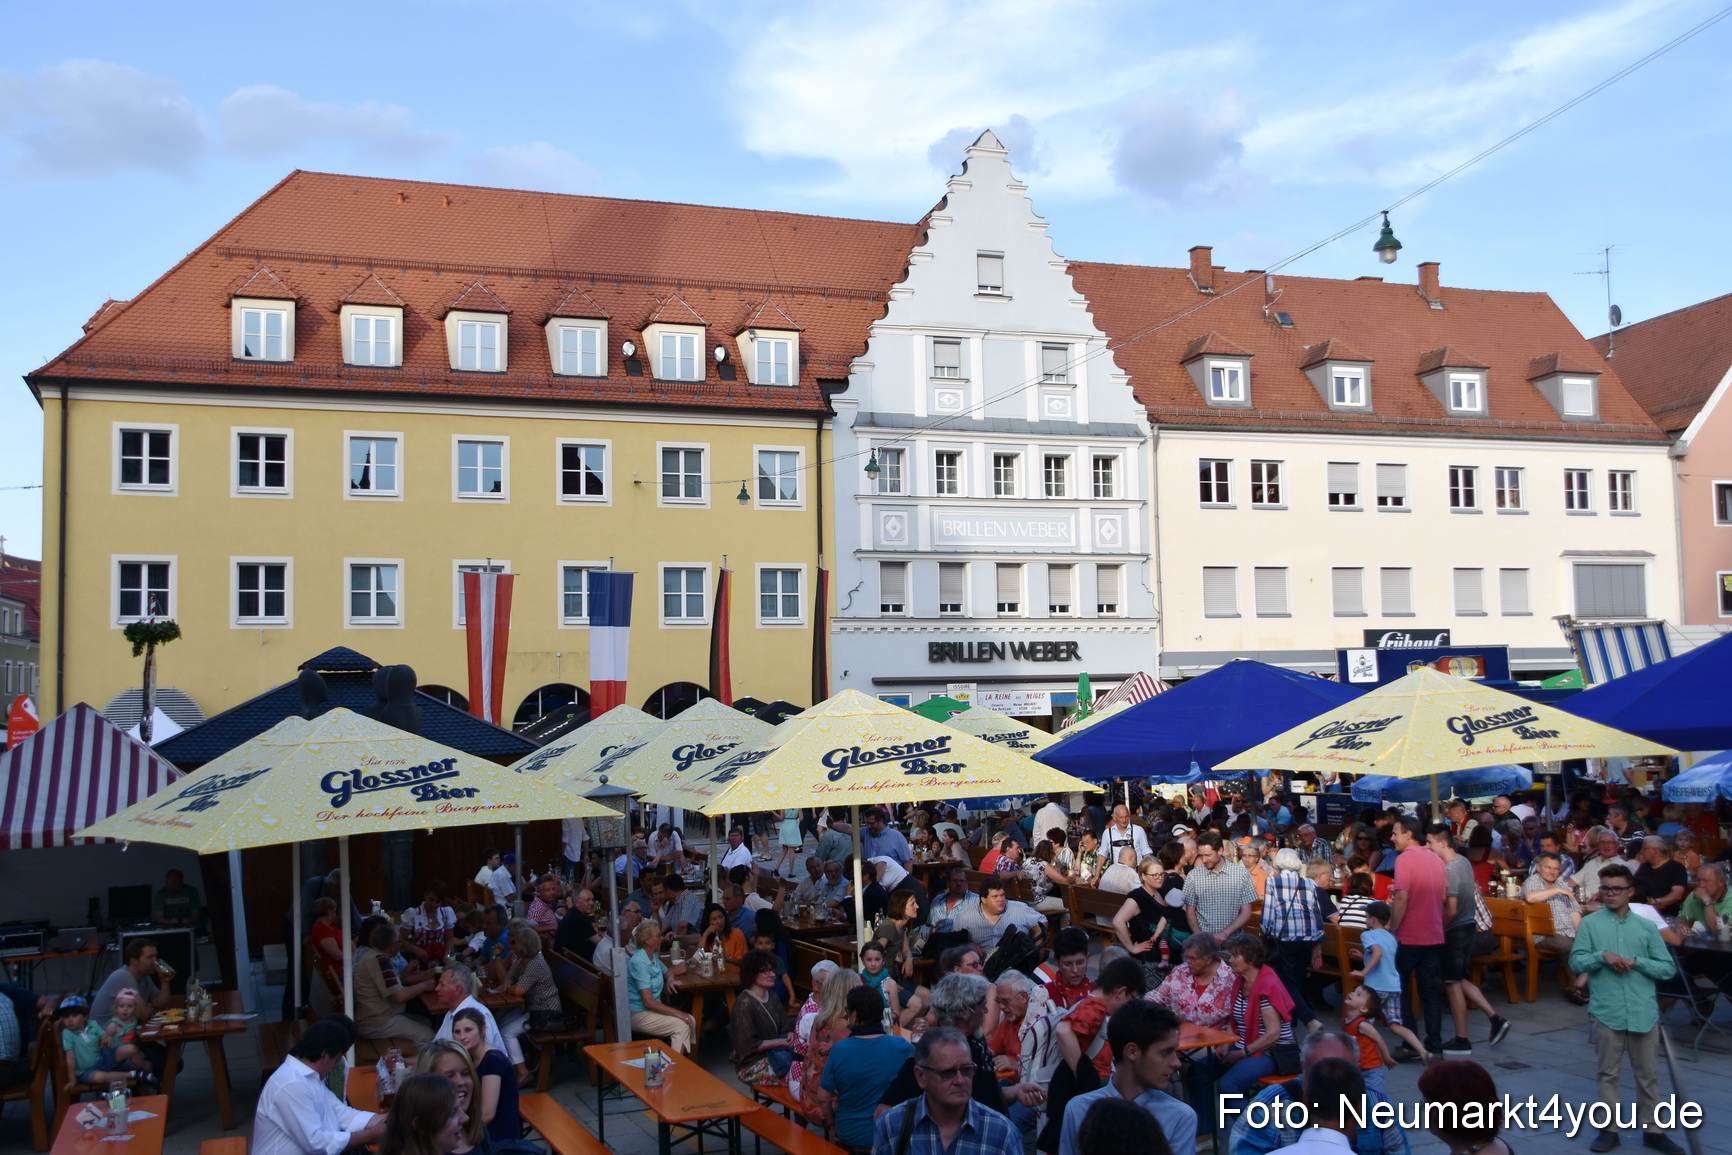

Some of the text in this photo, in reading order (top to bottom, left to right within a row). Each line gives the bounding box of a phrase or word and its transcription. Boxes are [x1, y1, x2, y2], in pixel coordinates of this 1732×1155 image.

[942, 519, 1069, 538] BRILLEN WEBER
[1376, 631, 1448, 649] frühauf
[928, 641, 1083, 663] BRILLEN WEBER
[984, 693, 993, 701] LA
[1294, 715, 1403, 750] Glossner
[1446, 706, 1539, 746] Glossner
[1511, 725, 1560, 740] Bier
[975, 730, 1030, 744] lossner
[1006, 740, 1038, 749] Bier
[822, 735, 951, 782] Glossner
[900, 758, 967, 776] Bier
[320, 757, 460, 809] Glossner
[410, 782, 481, 802] Bier
[811, 776, 1003, 793] Der hochfeine Biergenuss
[315, 801, 520, 823] Der hochfeine Biergenuss
